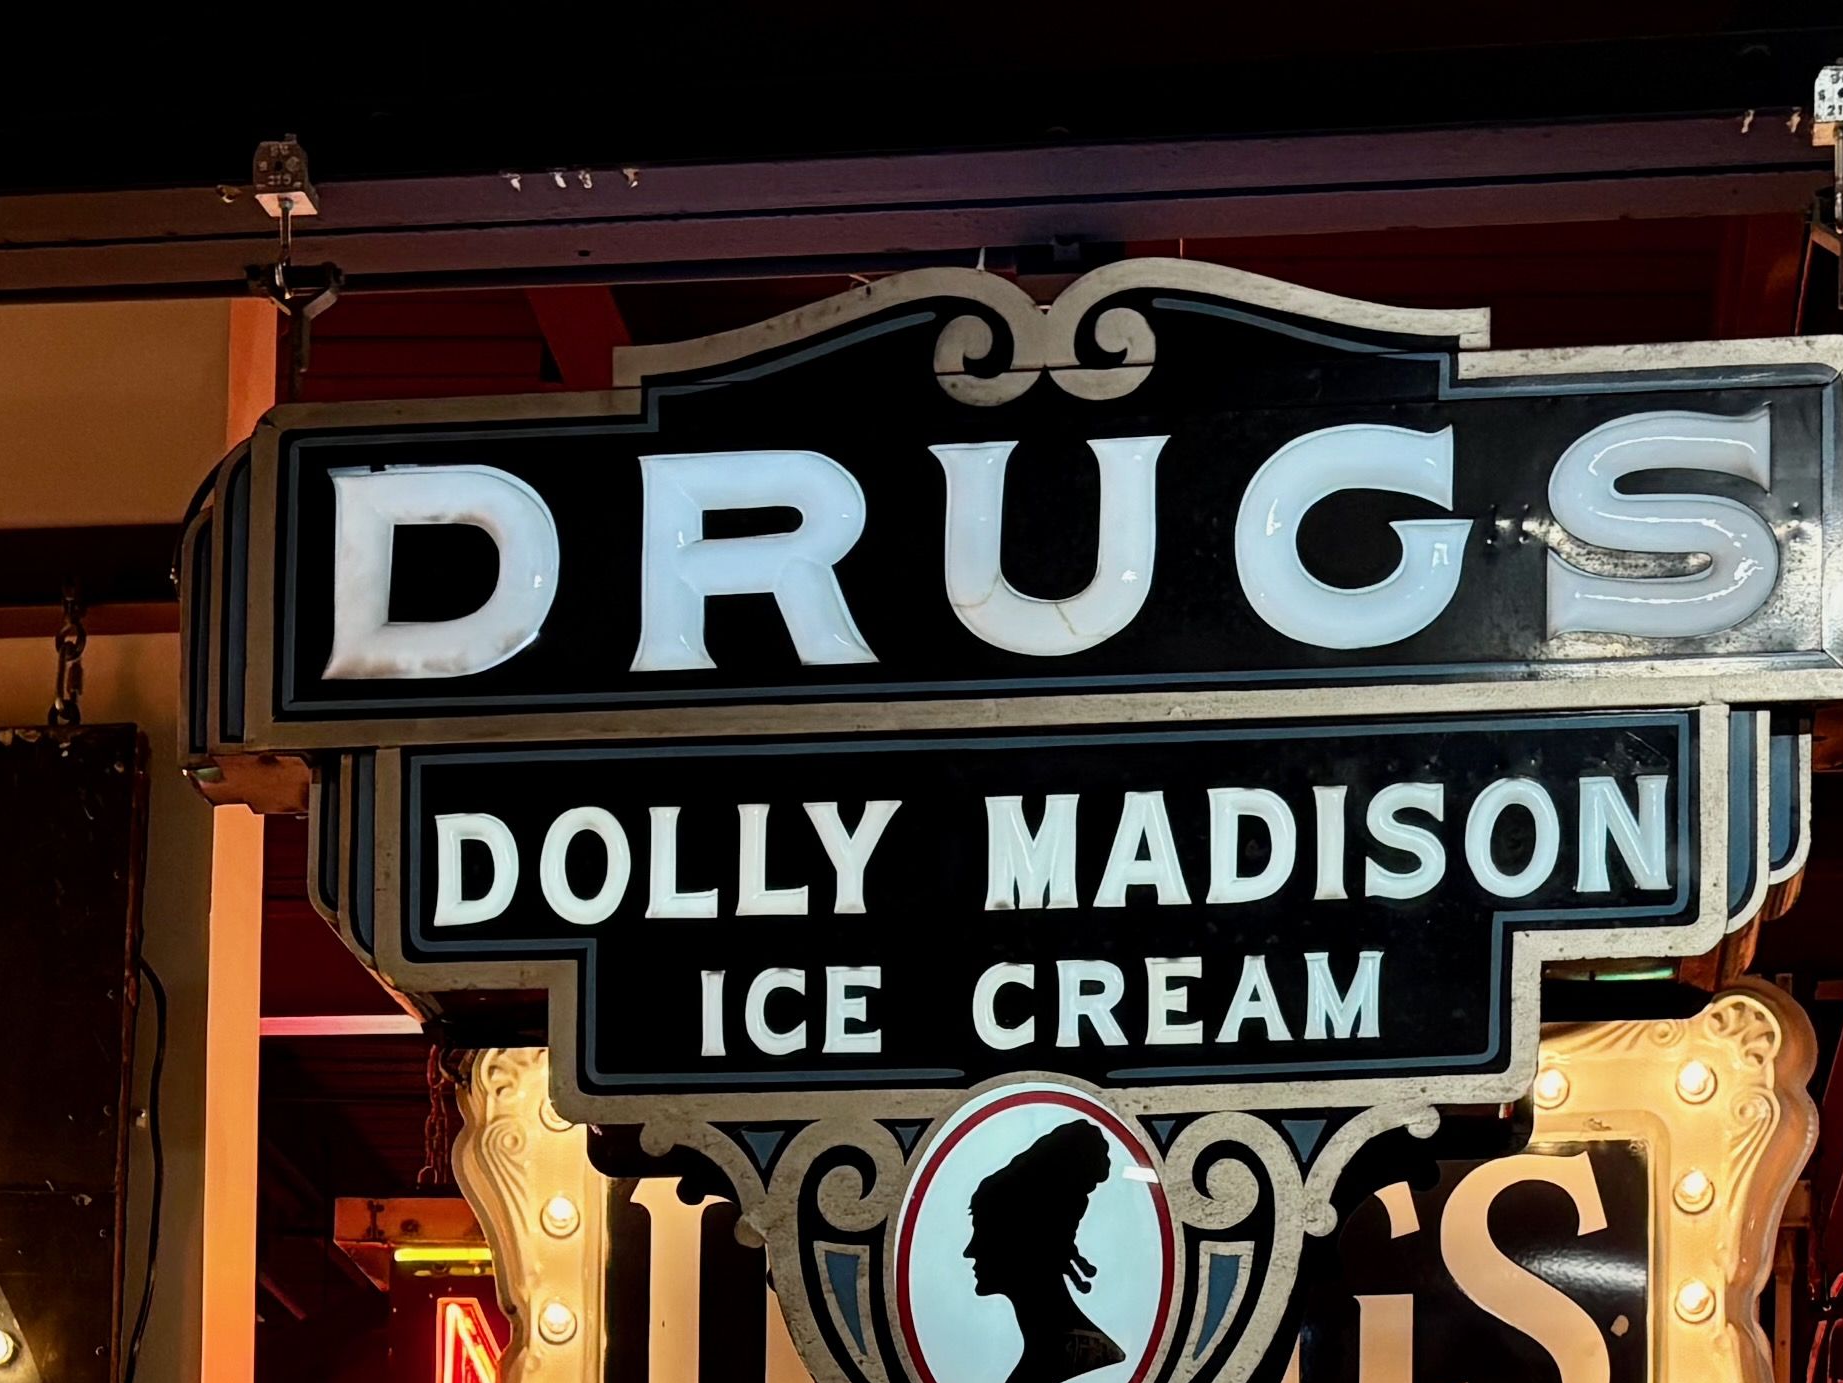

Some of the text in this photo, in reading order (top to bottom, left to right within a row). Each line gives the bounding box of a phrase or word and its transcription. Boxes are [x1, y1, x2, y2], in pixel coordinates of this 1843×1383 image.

[325, 403, 1782, 681] DRUGS
[431, 773, 1672, 929] DOLLY MADISON
[699, 950, 1385, 1058] ICE CREAM
